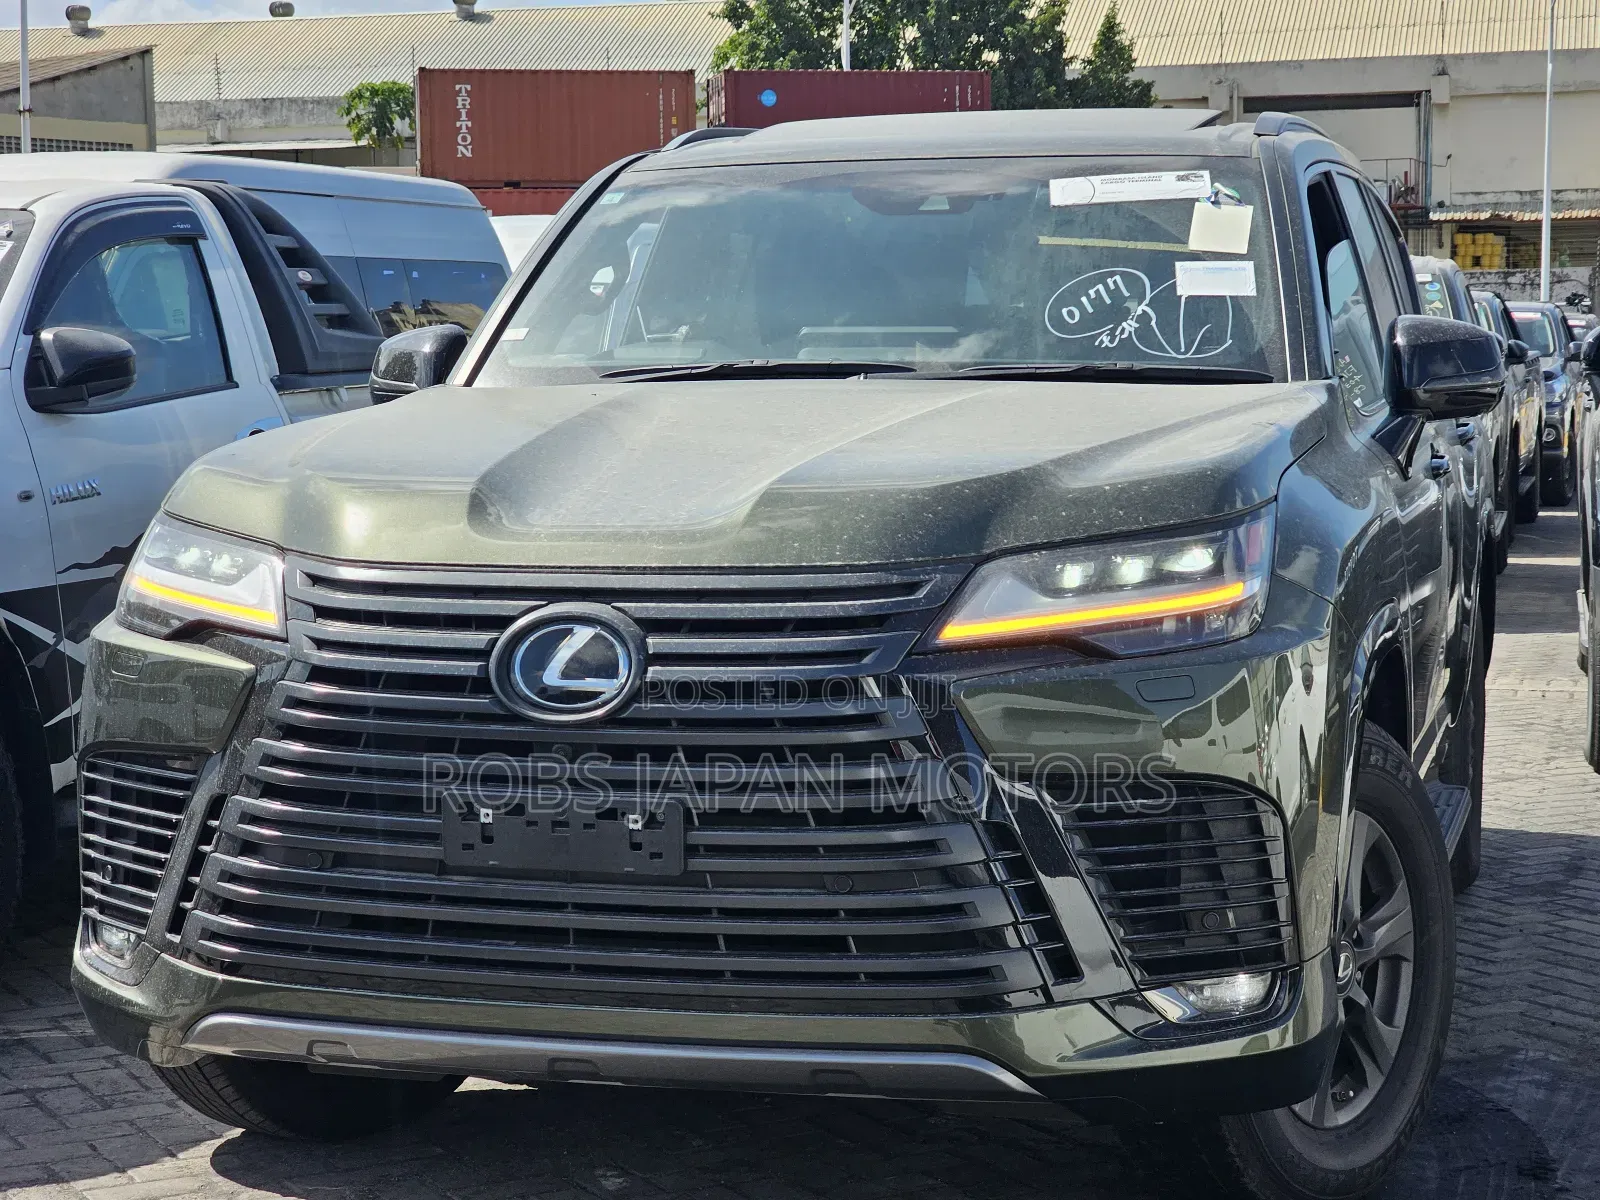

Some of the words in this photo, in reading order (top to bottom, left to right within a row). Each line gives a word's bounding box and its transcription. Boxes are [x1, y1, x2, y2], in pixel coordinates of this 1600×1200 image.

[455, 84, 473, 158] TRITON
[1062, 274, 1130, 324] 0177
[49, 479, 102, 505] HILUX
